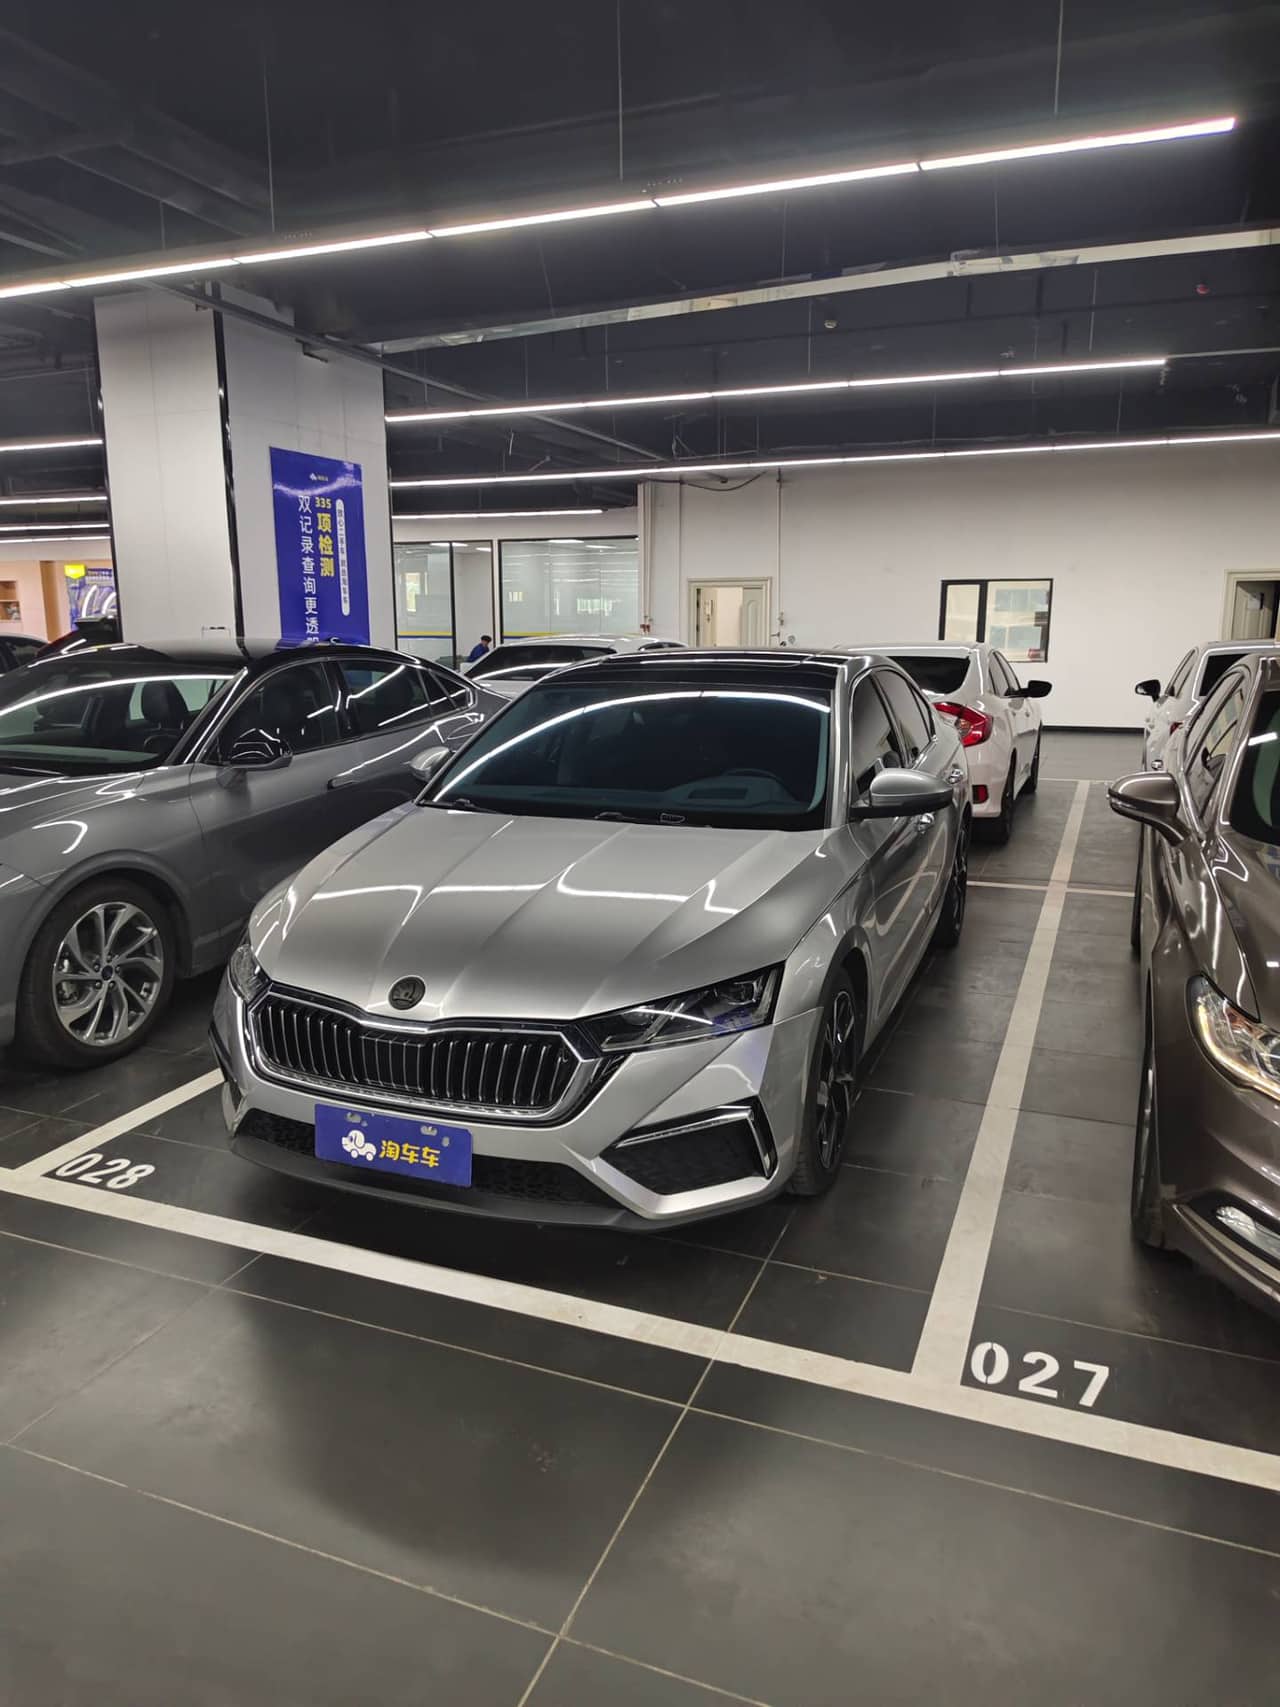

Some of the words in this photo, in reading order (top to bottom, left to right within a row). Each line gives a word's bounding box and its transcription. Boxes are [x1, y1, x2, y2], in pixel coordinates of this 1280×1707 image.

[56, 1153, 155, 1189] 028
[379, 1140, 441, 1168] 淘车车
[971, 1342, 1109, 1407] 027
